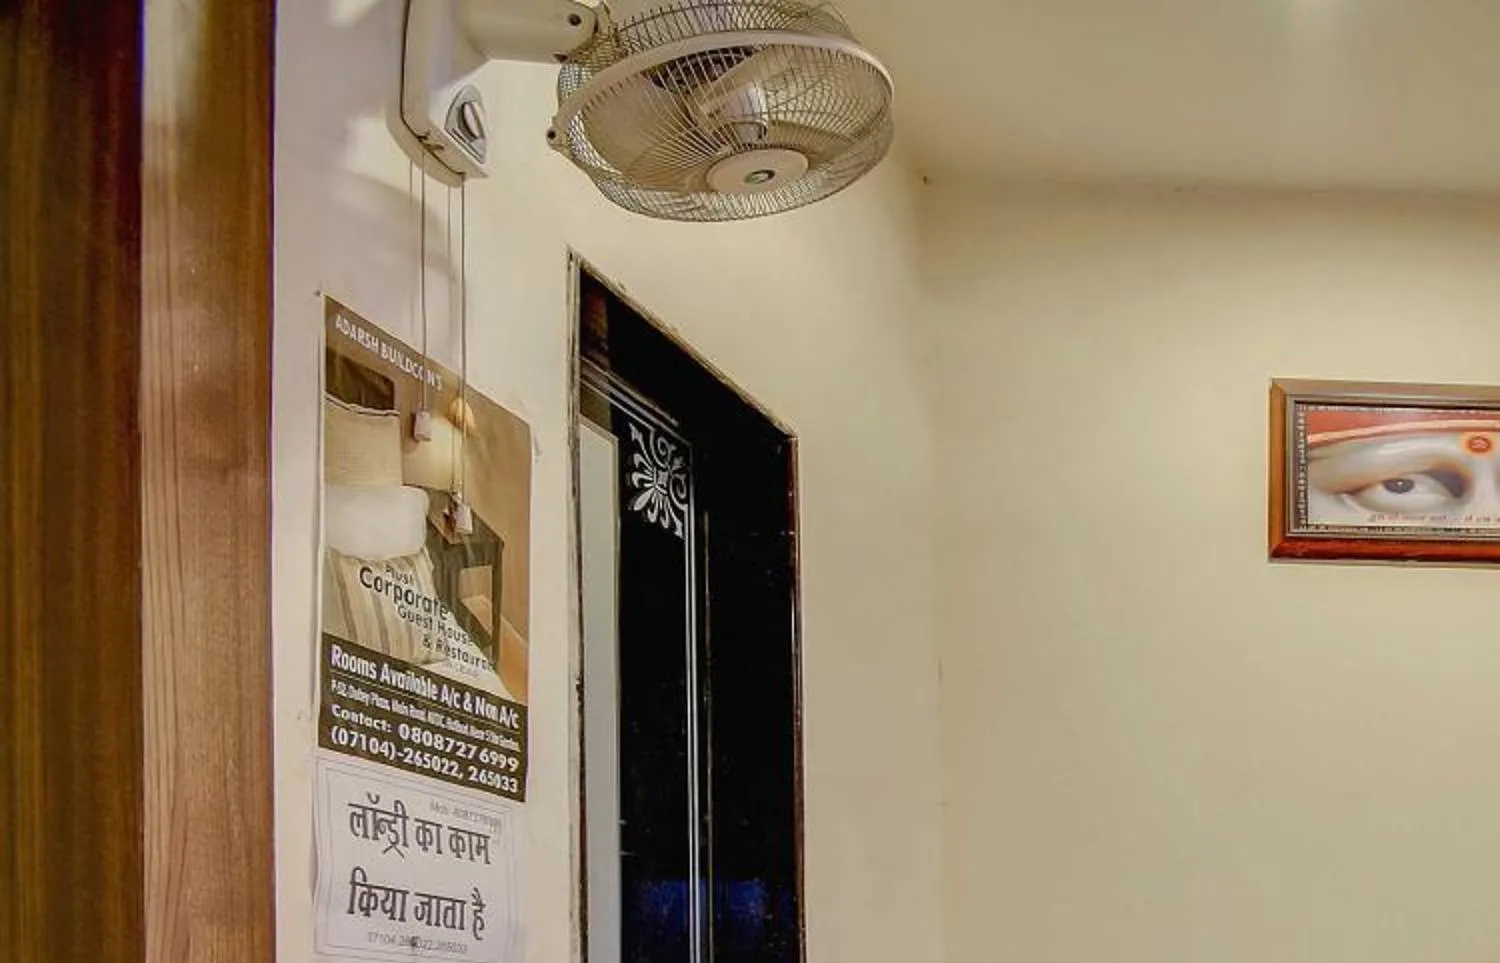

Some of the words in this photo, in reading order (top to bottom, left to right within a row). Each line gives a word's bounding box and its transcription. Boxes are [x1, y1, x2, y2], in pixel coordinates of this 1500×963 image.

[335, 314, 380, 356] ADARSH
[360, 566, 448, 620] Corporate
[397, 605, 433, 631] Guest
[423, 633, 431, 649] &
[436, 639, 496, 671] Restaura
[331, 644, 377, 680] Rooms
[380, 663, 438, 700] Available
[463, 691, 473, 713] &
[475, 696, 499, 721] Non
[331, 703, 393, 733] Contact:
[413, 818, 443, 855] का
[447, 825, 491, 864] काम
[346, 866, 409, 923] किया
[414, 891, 467, 931] जाता
[470, 887, 487, 941] है
